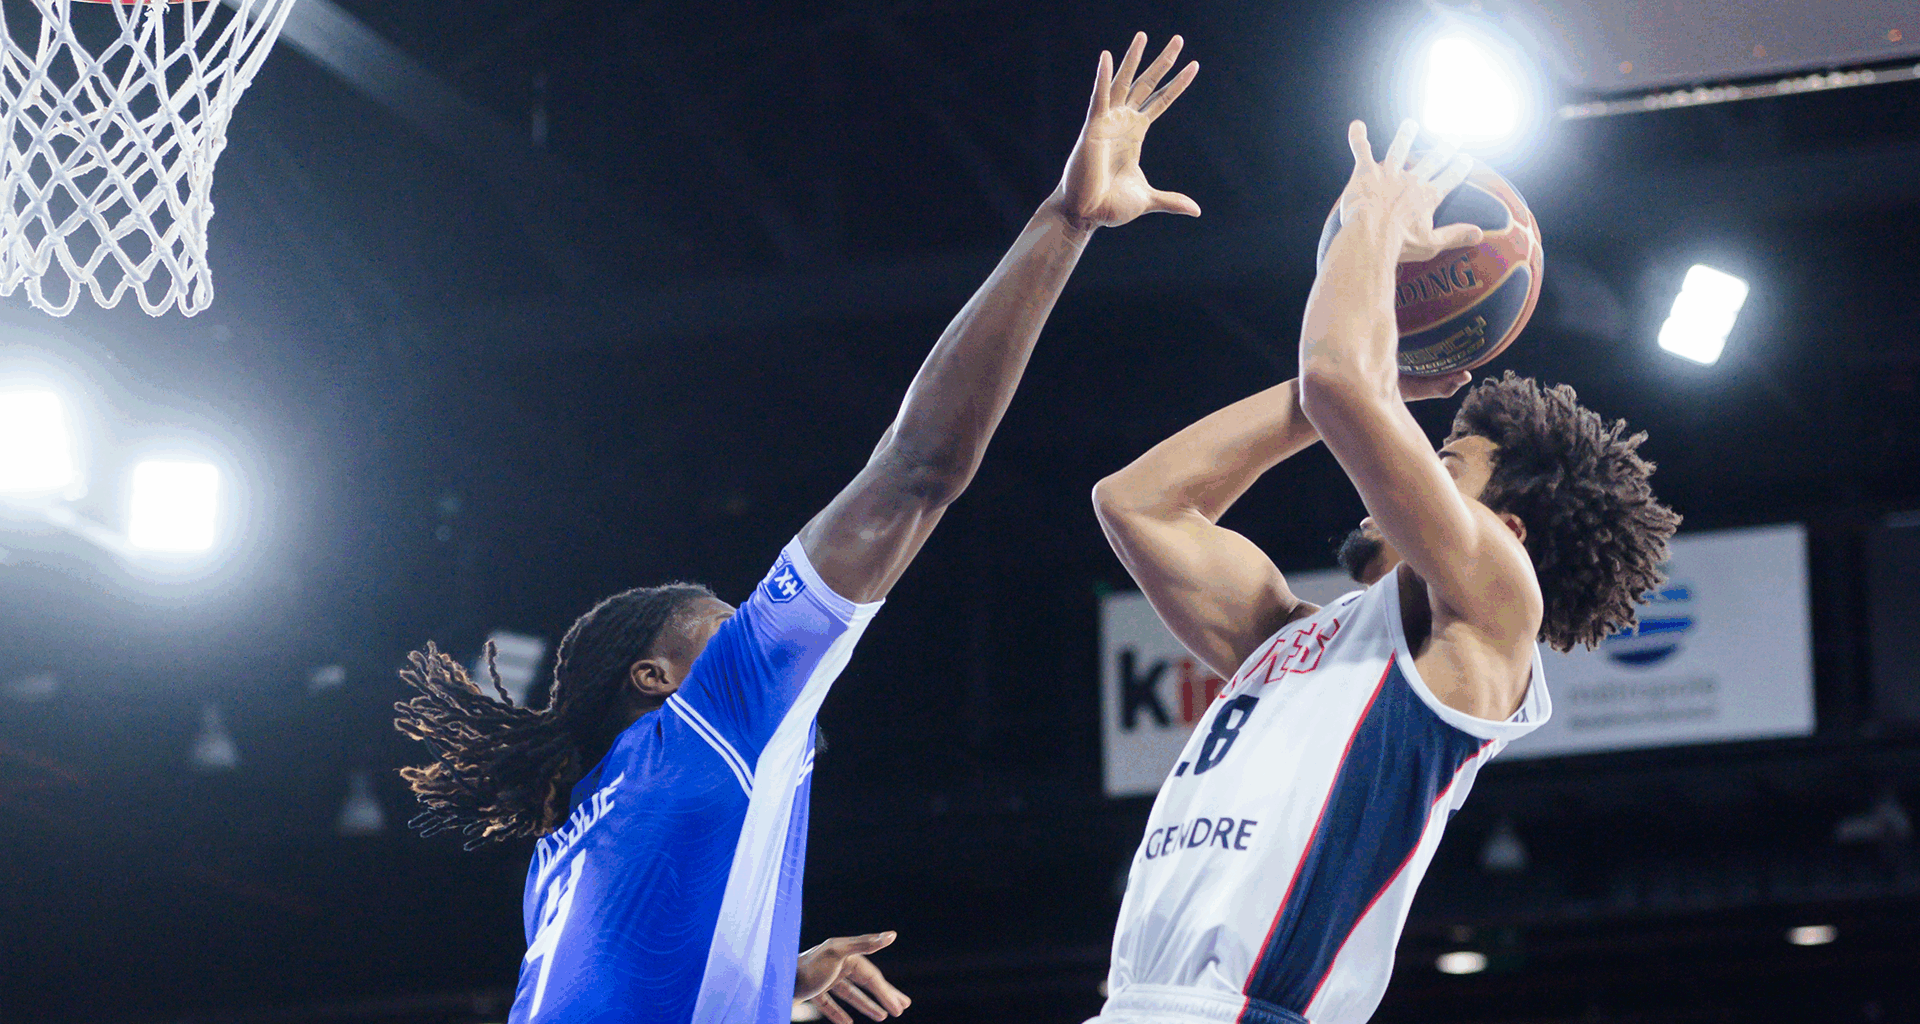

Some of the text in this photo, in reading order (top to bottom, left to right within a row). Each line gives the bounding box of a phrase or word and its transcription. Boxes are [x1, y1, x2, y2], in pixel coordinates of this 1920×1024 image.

[1395, 252, 1478, 308] DING
[1175, 693, 1260, 777] 8
[1143, 816, 1258, 862] GENDRE
